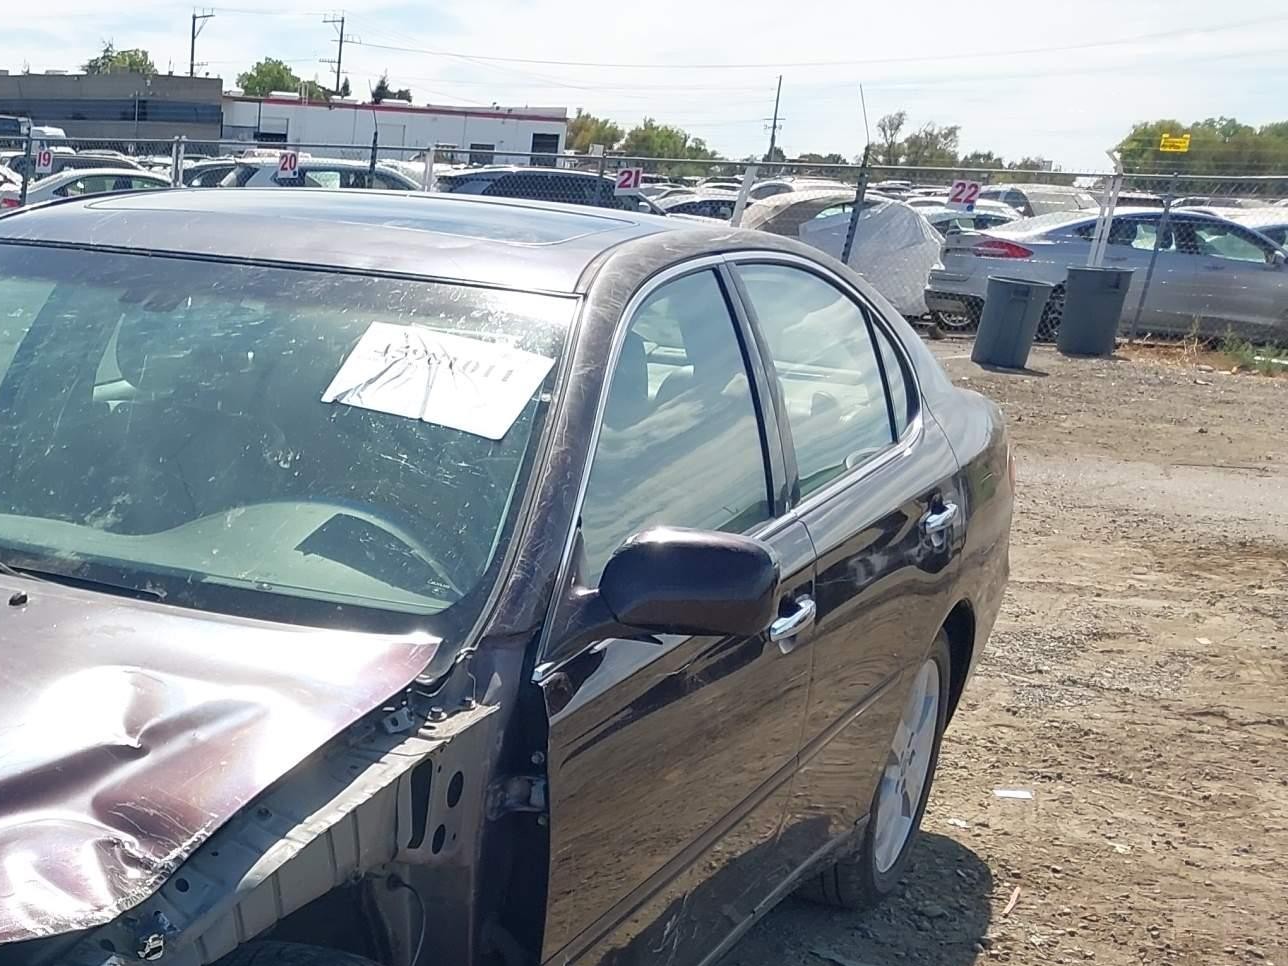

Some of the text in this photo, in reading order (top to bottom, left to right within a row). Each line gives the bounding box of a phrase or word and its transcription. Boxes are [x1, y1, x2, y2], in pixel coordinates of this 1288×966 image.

[37, 151, 51, 167] 19
[280, 154, 297, 171] 20
[618, 169, 640, 188] 21
[951, 182, 978, 204] 22
